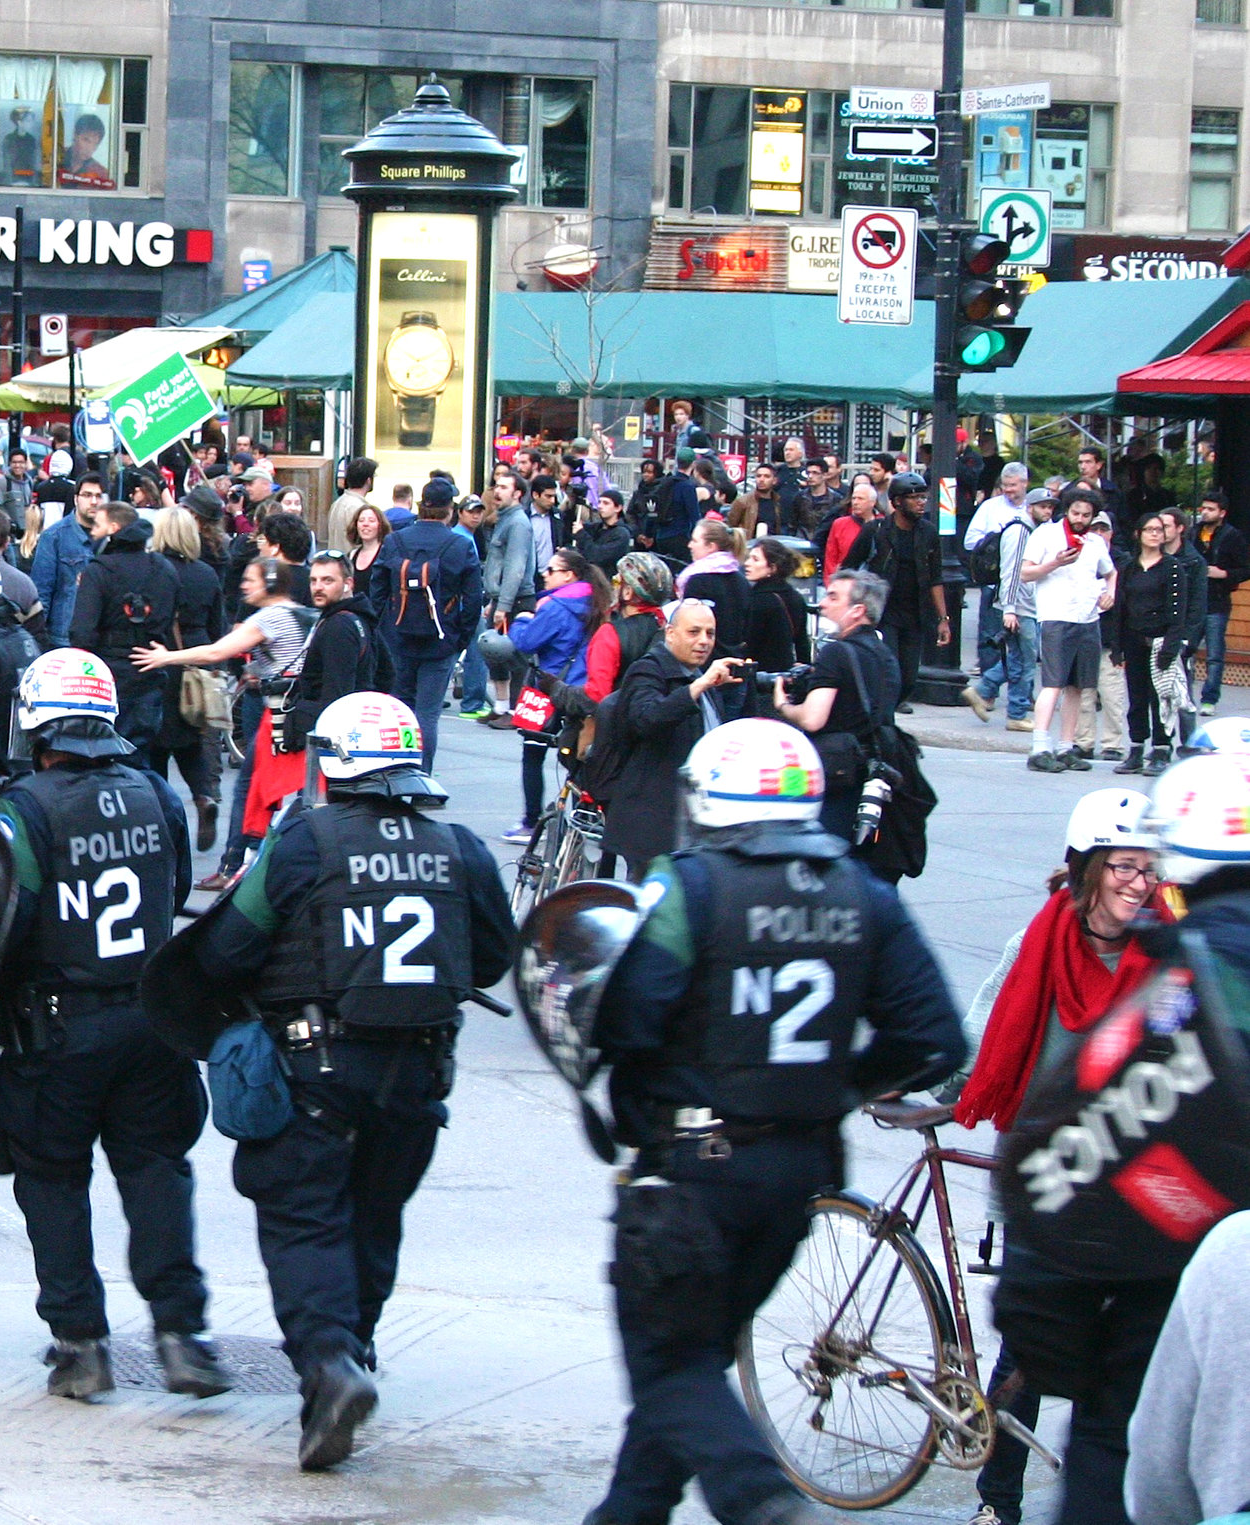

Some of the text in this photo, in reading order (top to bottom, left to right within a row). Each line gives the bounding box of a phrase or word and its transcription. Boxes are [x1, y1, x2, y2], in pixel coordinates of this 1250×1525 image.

[858, 96, 903, 111] Union
[977, 92, 1045, 110] Sainte-Catherine
[380, 165, 466, 181] Square Phillips
[838, 171, 886, 182] JEWELLERY
[848, 181, 874, 191] TOOLS
[892, 183, 931, 193] SUPPLIES
[38, 217, 174, 268] KING
[1130, 251, 1148, 259] LES
[397, 269, 447, 283] Cellini
[1110, 255, 1217, 281] SECOND
[849, 297, 902, 308] LIVRAISON
[856, 310, 894, 320] LOCALE
[82, 662, 97, 676] 2
[404, 731, 414, 748] 2
[97, 790, 127, 819] GI
[379, 816, 414, 842] GI
[70, 823, 161, 866] POLICE
[349, 854, 450, 885] POLICE
[746, 904, 862, 944] POLICE
[1016, 1030, 1216, 1213] POLICE
